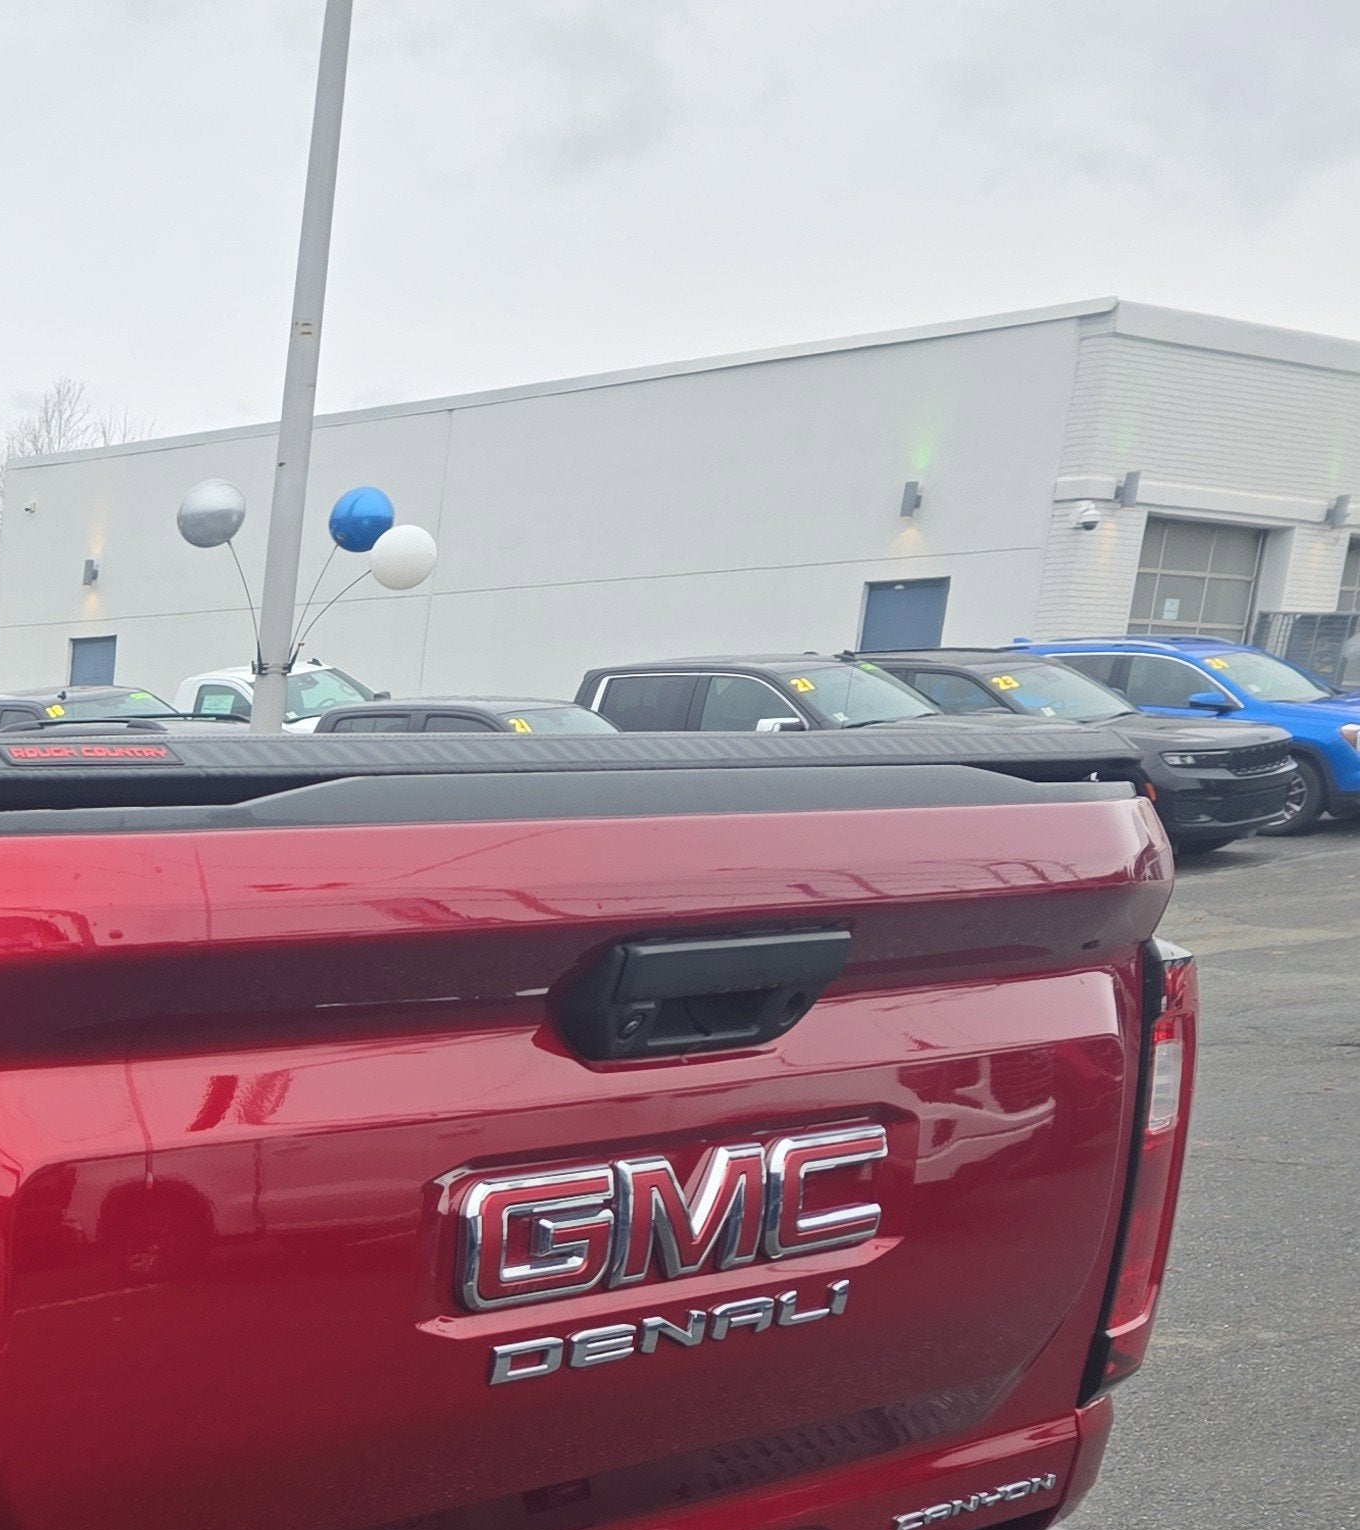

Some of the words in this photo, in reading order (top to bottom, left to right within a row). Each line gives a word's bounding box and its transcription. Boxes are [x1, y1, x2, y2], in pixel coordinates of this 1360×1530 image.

[790, 677, 816, 693] 21
[991, 674, 1020, 691] 23
[9, 745, 78, 759] ROUGH
[81, 745, 168, 759] COUNTRY
[454, 1123, 889, 1312] GMC
[489, 1278, 851, 1386] DENALI
